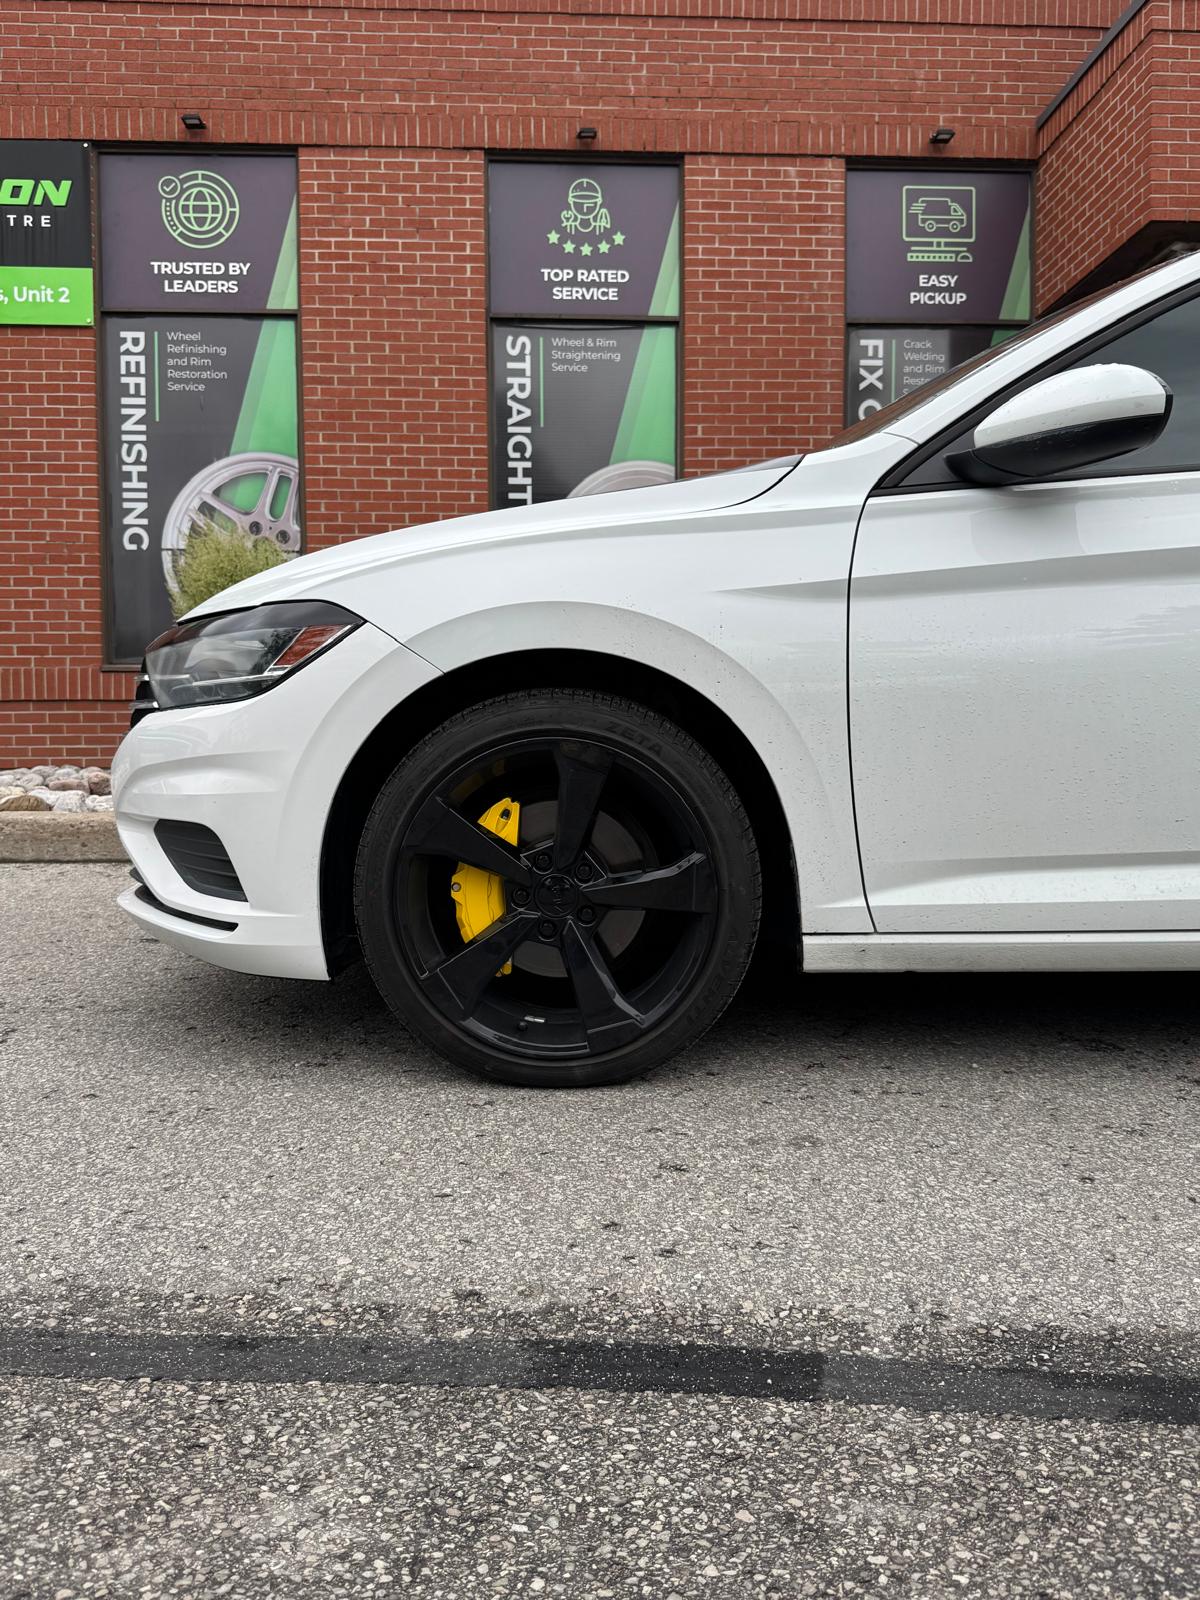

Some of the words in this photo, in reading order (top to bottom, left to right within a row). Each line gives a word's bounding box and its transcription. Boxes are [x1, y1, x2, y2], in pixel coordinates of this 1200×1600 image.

[6, 214, 52, 228] TRE
[150, 261, 225, 276] TRUSTED
[228, 262, 251, 276] BY
[541, 268, 574, 282] TOP
[577, 269, 630, 283] RATED
[918, 274, 959, 288] EASY
[163, 279, 239, 294] LEADERS
[13, 285, 54, 302] Unit
[58, 287, 70, 303] 2
[552, 286, 619, 301] SERVICE
[909, 292, 967, 305] PICKUP
[166, 331, 201, 341] Wheel
[551, 337, 585, 348] Wheel
[586, 337, 595, 347] &
[596, 338, 617, 348] Rim
[903, 339, 933, 349] Crack
[167, 344, 227, 356] Refinishing
[551, 350, 621, 362] Straightening
[167, 357, 188, 366] and
[190, 357, 212, 367] Rim
[903, 351, 946, 362] Welding
[551, 363, 589, 373] Service
[859, 339, 883, 391] FIX
[903, 363, 923, 374] and
[925, 364, 946, 374] Rim
[167, 369, 228, 380] Restoration
[167, 382, 206, 392] Service
[119, 331, 150, 551] REFINISHING
